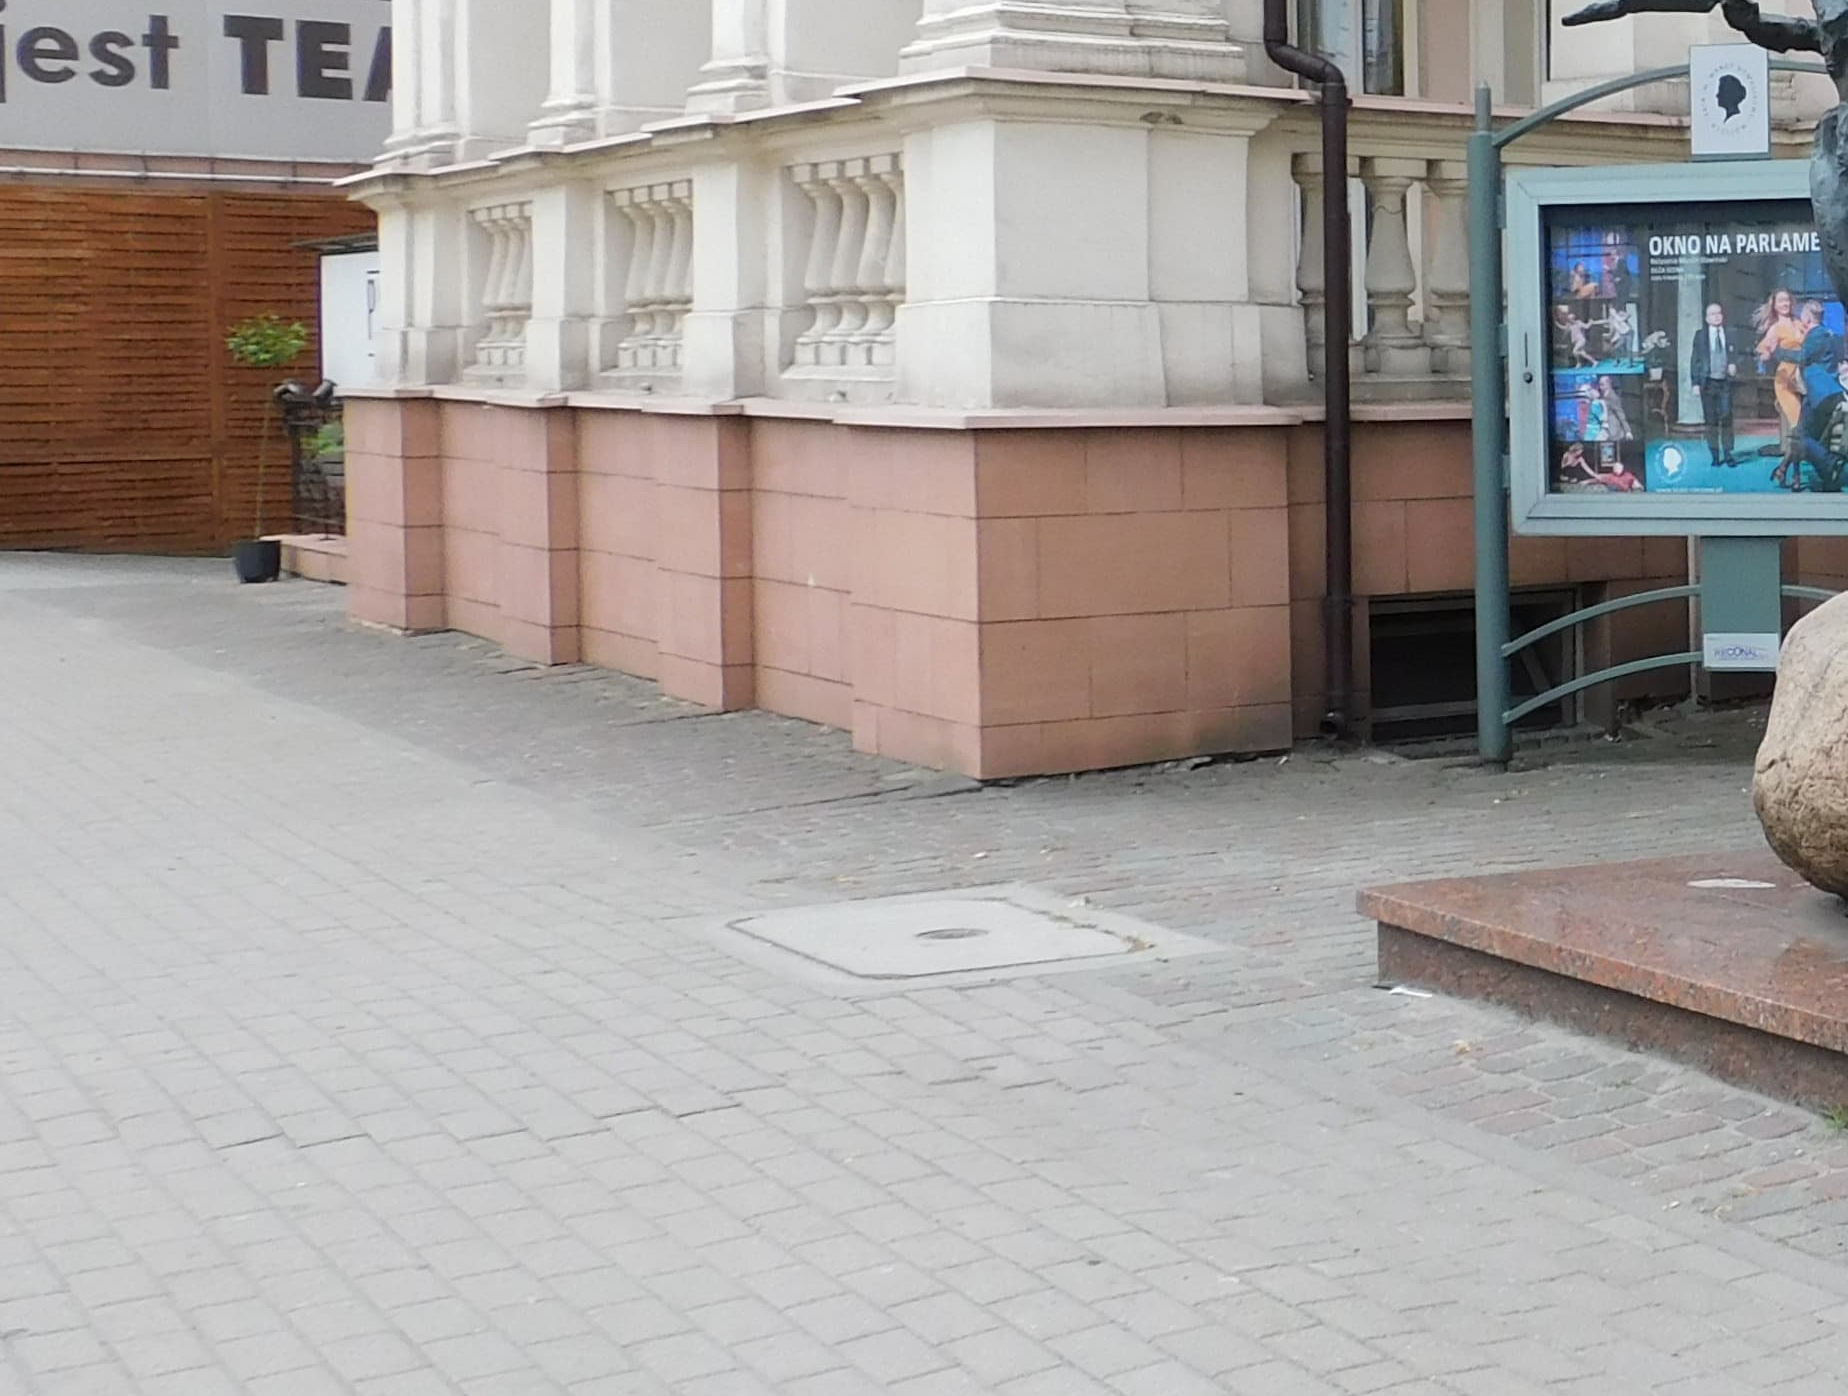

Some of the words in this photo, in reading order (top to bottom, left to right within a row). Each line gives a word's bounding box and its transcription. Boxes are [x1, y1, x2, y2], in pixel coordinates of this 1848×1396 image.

[1649, 235, 1700, 256] OKNO
[1705, 234, 1732, 254] NA
[1736, 231, 1821, 254] PARLAME
